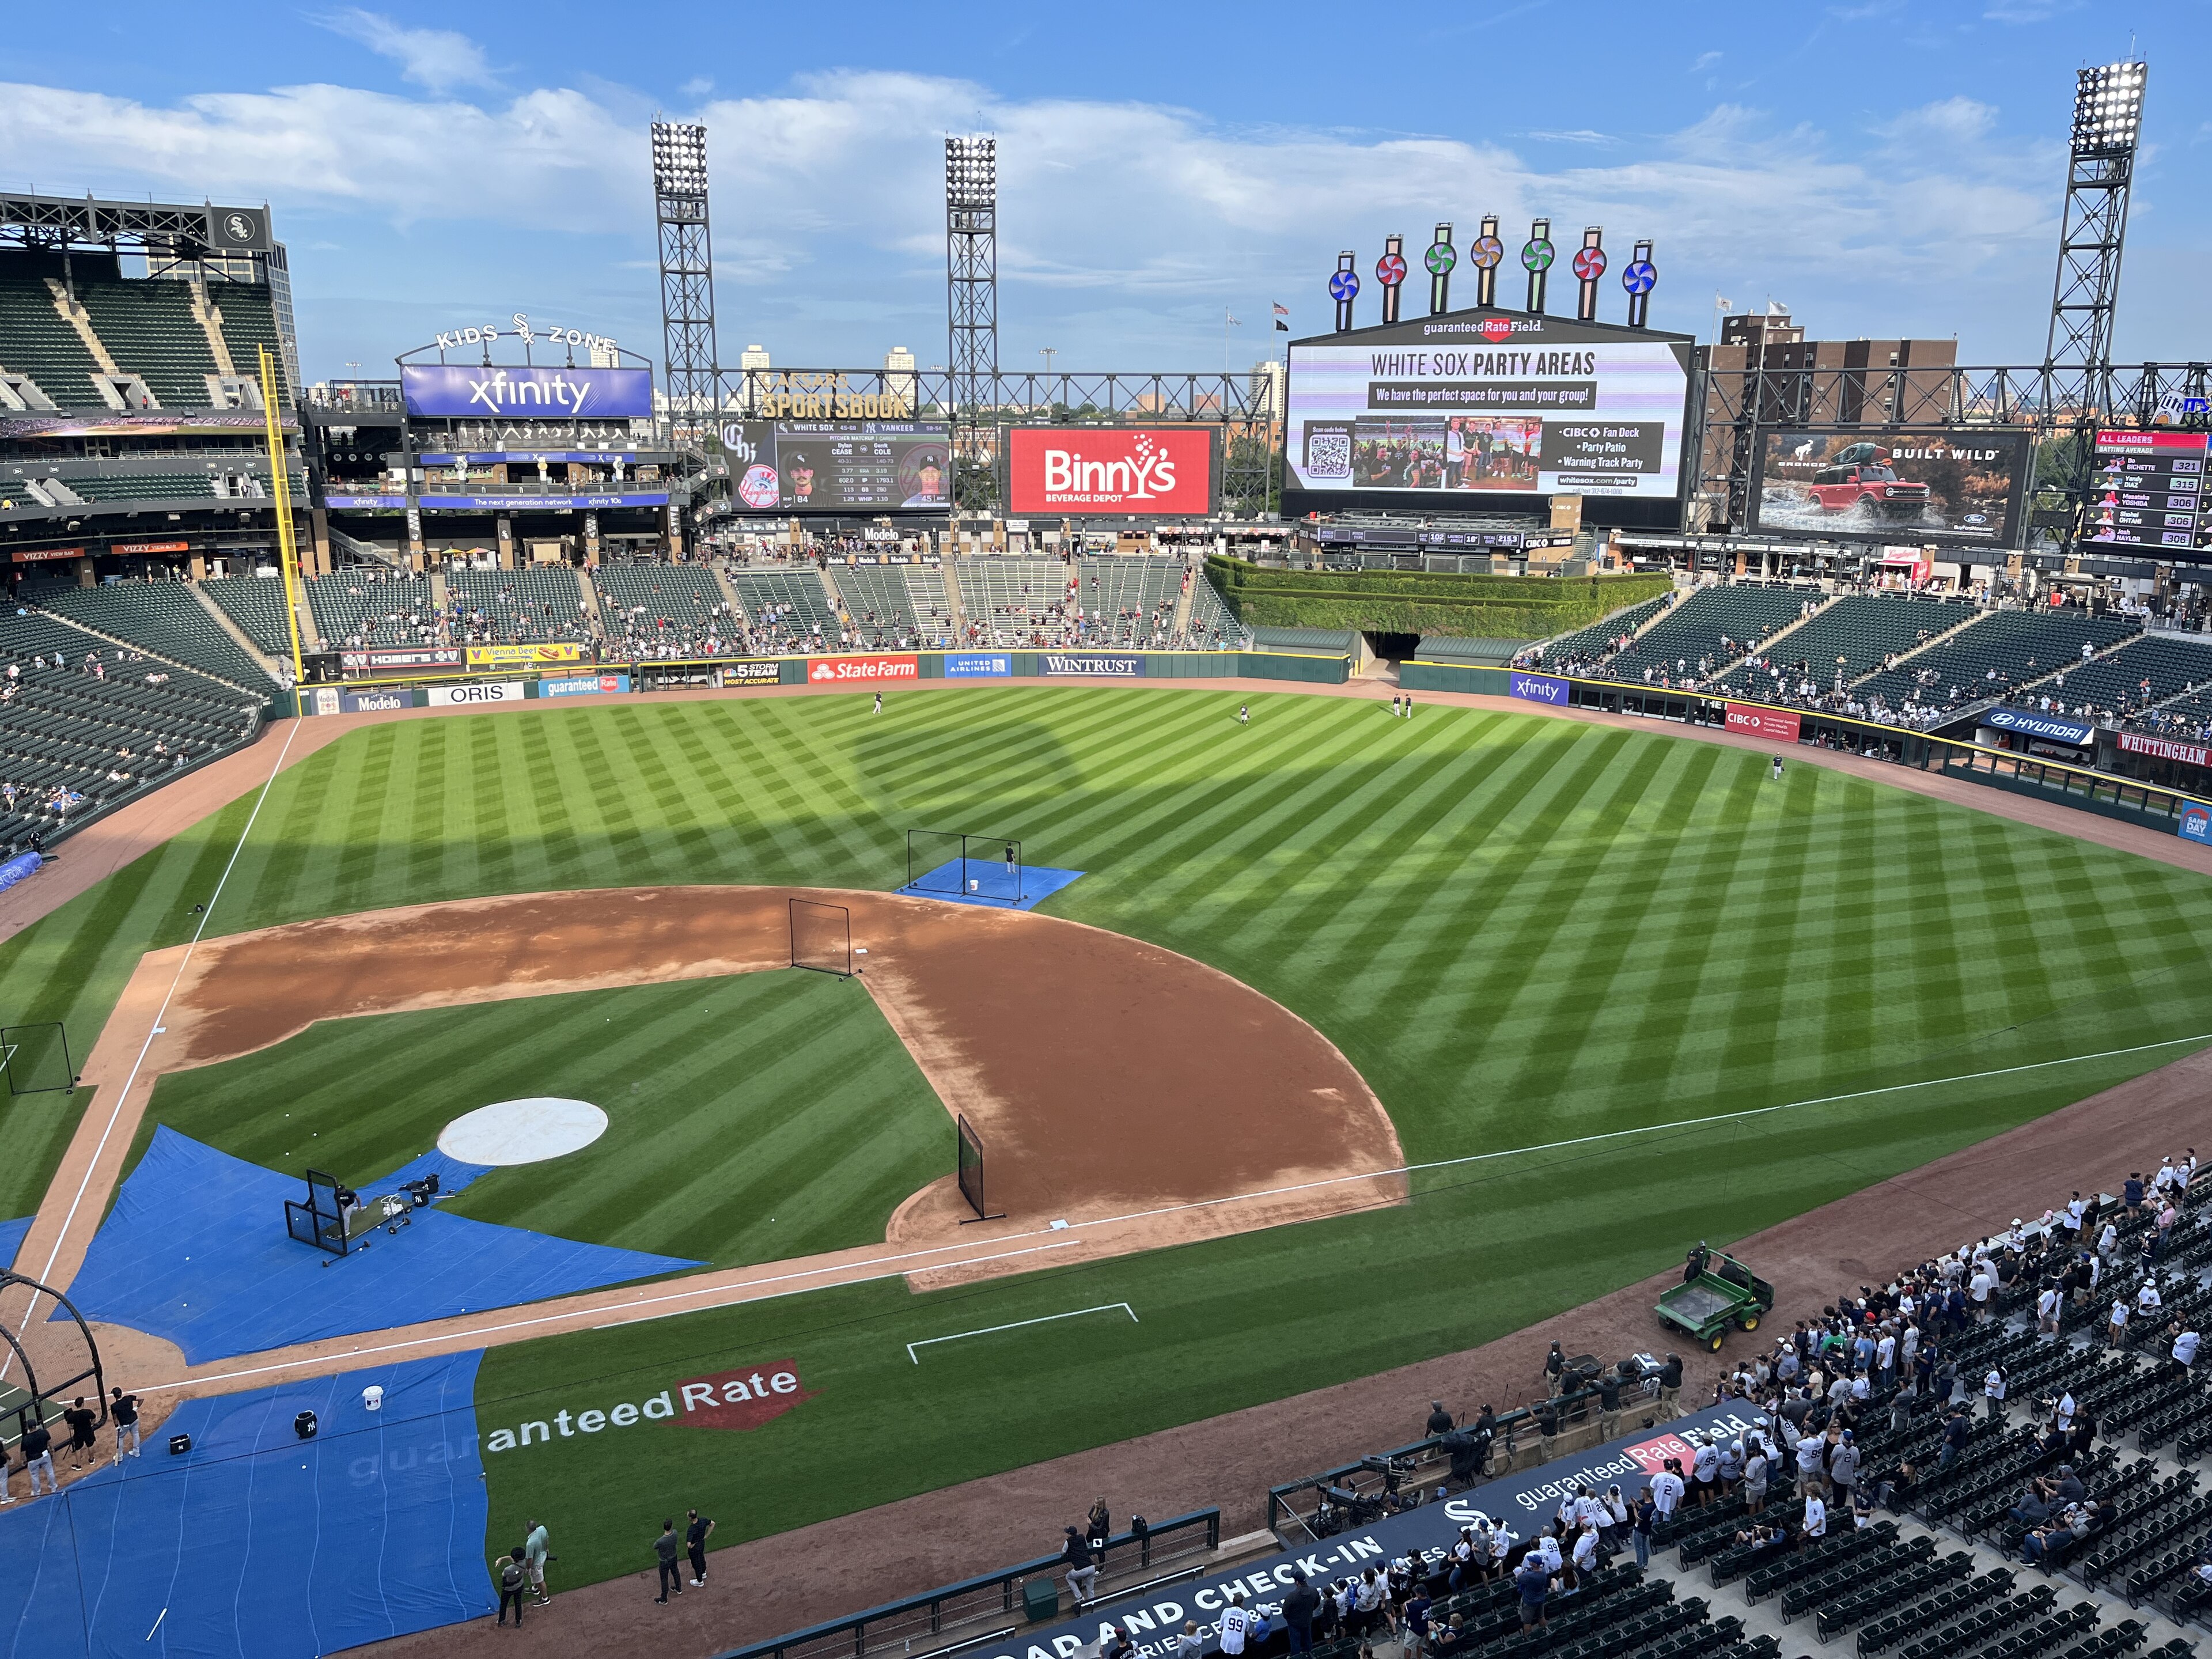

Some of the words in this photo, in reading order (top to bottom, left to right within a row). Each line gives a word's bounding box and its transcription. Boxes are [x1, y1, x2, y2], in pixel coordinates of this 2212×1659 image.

[1424, 321, 1484, 335] guaranteed
[1485, 321, 1509, 332] Rate
[435, 324, 498, 350] KIDS
[548, 325, 617, 355] ZONE
[1372, 354, 1426, 376] WHITE
[1433, 353, 1469, 376] SOX
[1474, 352, 1532, 376] PARTY
[1535, 351, 1595, 375] AREAS
[762, 373, 849, 389] CAESARS
[469, 371, 590, 414] xfinity
[1376, 388, 1391, 401] We
[1391, 389, 1411, 401] have
[1412, 389, 1426, 401] the
[1427, 388, 1460, 404] perfect
[1461, 391, 1486, 404] space
[1488, 388, 1499, 400] for
[1502, 391, 1518, 403] you
[1520, 388, 1536, 401] and
[1538, 391, 1557, 403] your
[1559, 388, 1589, 404] group!
[762, 393, 909, 419] SPORTSBOOK
[2160, 396, 2183, 412] Lite
[1563, 427, 1589, 437] CIBC
[1603, 427, 1617, 437] Fan
[1619, 427, 1639, 438] Deck
[2117, 435, 2153, 444] LEADERS
[1582, 442, 1604, 453] Party
[1605, 442, 1626, 452] Patio
[1892, 448, 1944, 459] BUILT
[1563, 457, 1596, 469] Warning
[1597, 457, 1619, 467] Track
[1621, 457, 1643, 469] Party
[354, 498, 378, 506] xfinity
[505, 499, 543, 507] generation
[1093, 494, 1123, 502] DEPOT
[865, 528, 899, 540] Modelo
[1525, 539, 1541, 548] CIBC
[24, 552, 48, 560] VIZZY
[486, 647, 516, 656] Vienna
[518, 646, 537, 655] Beef
[1046, 656, 1137, 672] WINTRUST
[737, 664, 748, 677] 5
[548, 678, 598, 696] guaranteed
[601, 679, 616, 687] Rate
[1517, 679, 1559, 701] xfinity
[451, 685, 503, 702] ORIS
[358, 696, 401, 711] Modelo
[1728, 713, 1751, 725] CIBC
[2014, 718, 2083, 740] HYUNDAI
[2121, 733, 2206, 766] WHITTINGHAM
[2187, 822, 2206, 833] DAY
[2188, 817, 2207, 826] SAME
[680, 1371, 798, 1412] Rate
[1810, 1448, 1823, 1459] 99
[1844, 1453, 1851, 1463] 2
[1705, 1456, 1717, 1466] 99
[1516, 1453, 1638, 1511] guaranteed
[1632, 1440, 1687, 1465] Rate
[1663, 1477, 1676, 1485] JETER
[1664, 1485, 1672, 1496] 2
[1585, 1503, 1592, 1513] 11
[1547, 1543, 1558, 1553] 99
[1099, 1601, 1184, 1646] AND
[1194, 1536, 1384, 1610] CHECK-IN
[1228, 1618, 1244, 1633] 99
